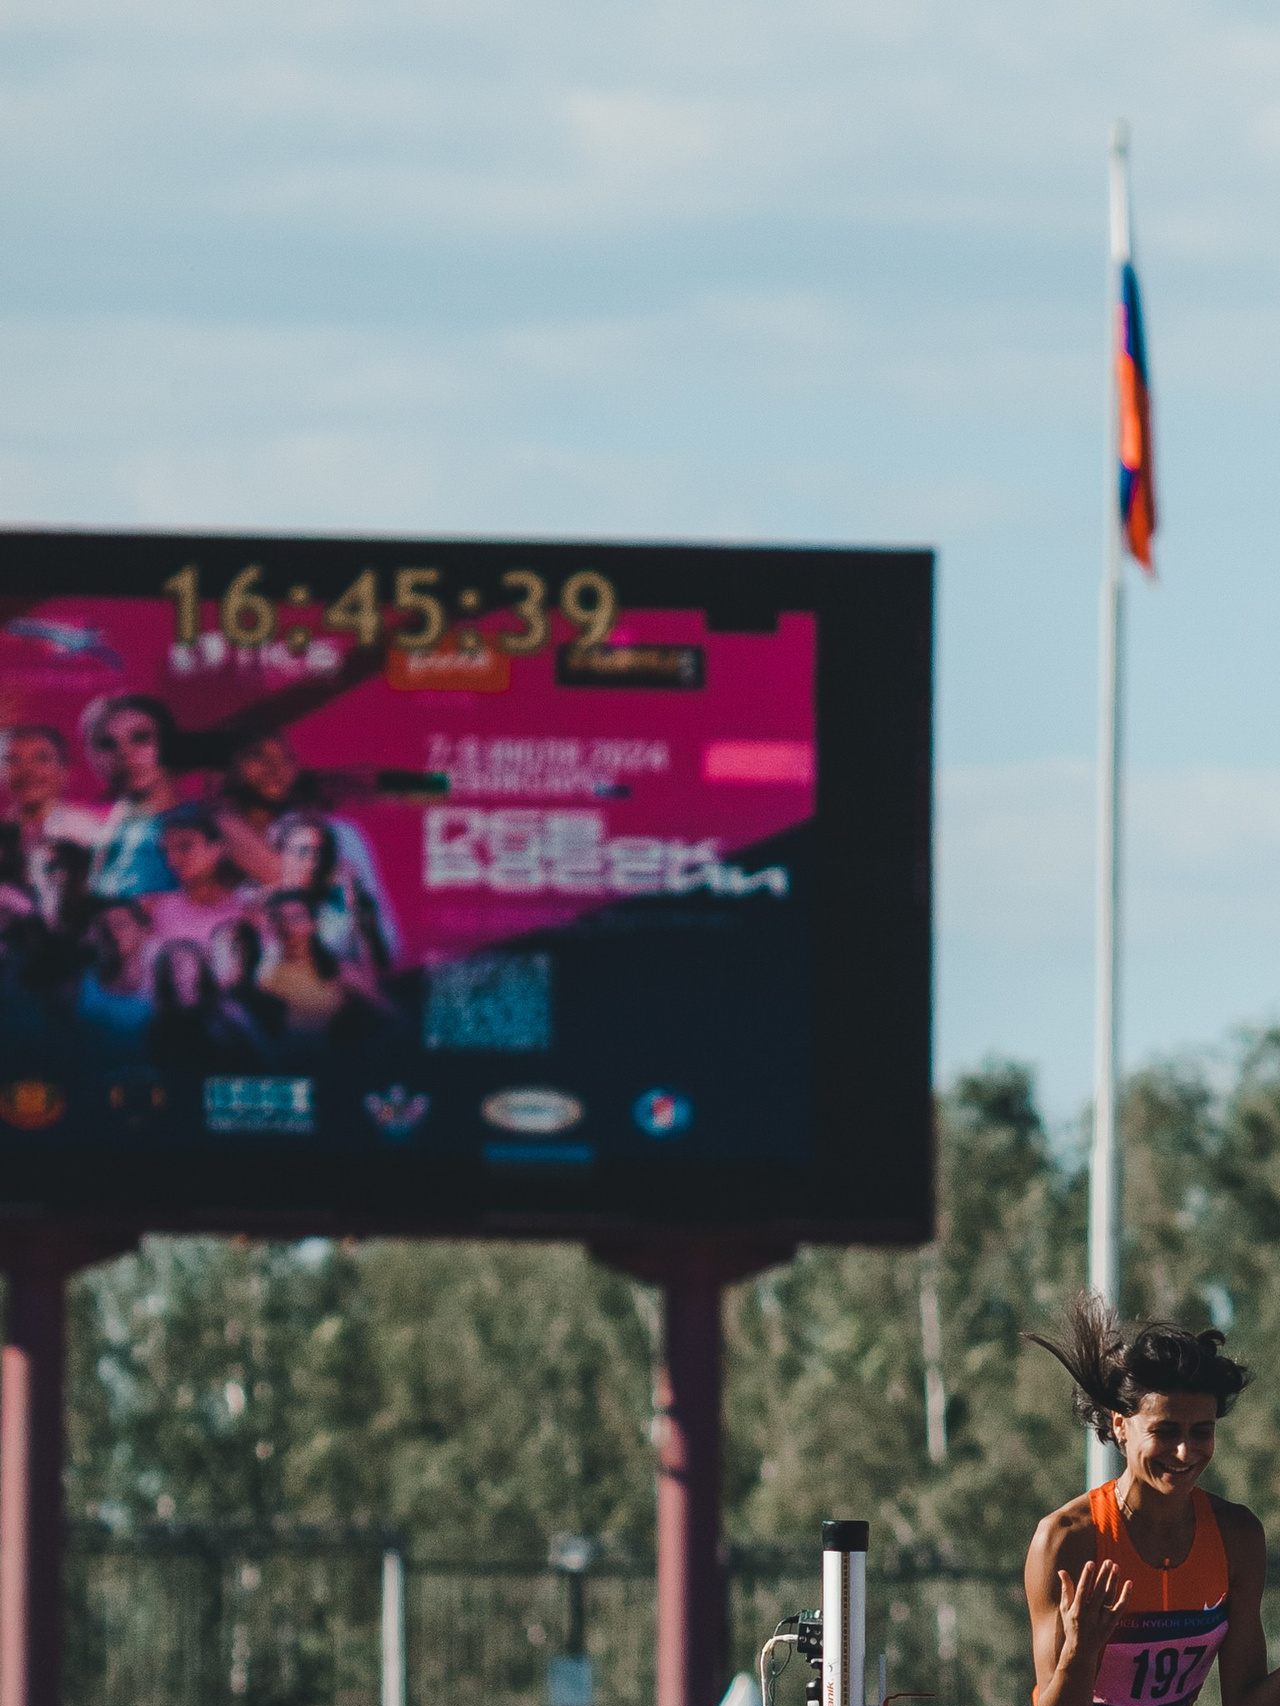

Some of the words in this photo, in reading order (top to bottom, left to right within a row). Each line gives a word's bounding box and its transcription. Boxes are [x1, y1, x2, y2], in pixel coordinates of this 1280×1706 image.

[164, 565, 617, 653] 16:45:39
[1142, 1618, 1180, 1629] КУБОК
[1132, 1646, 1206, 1698] 197
